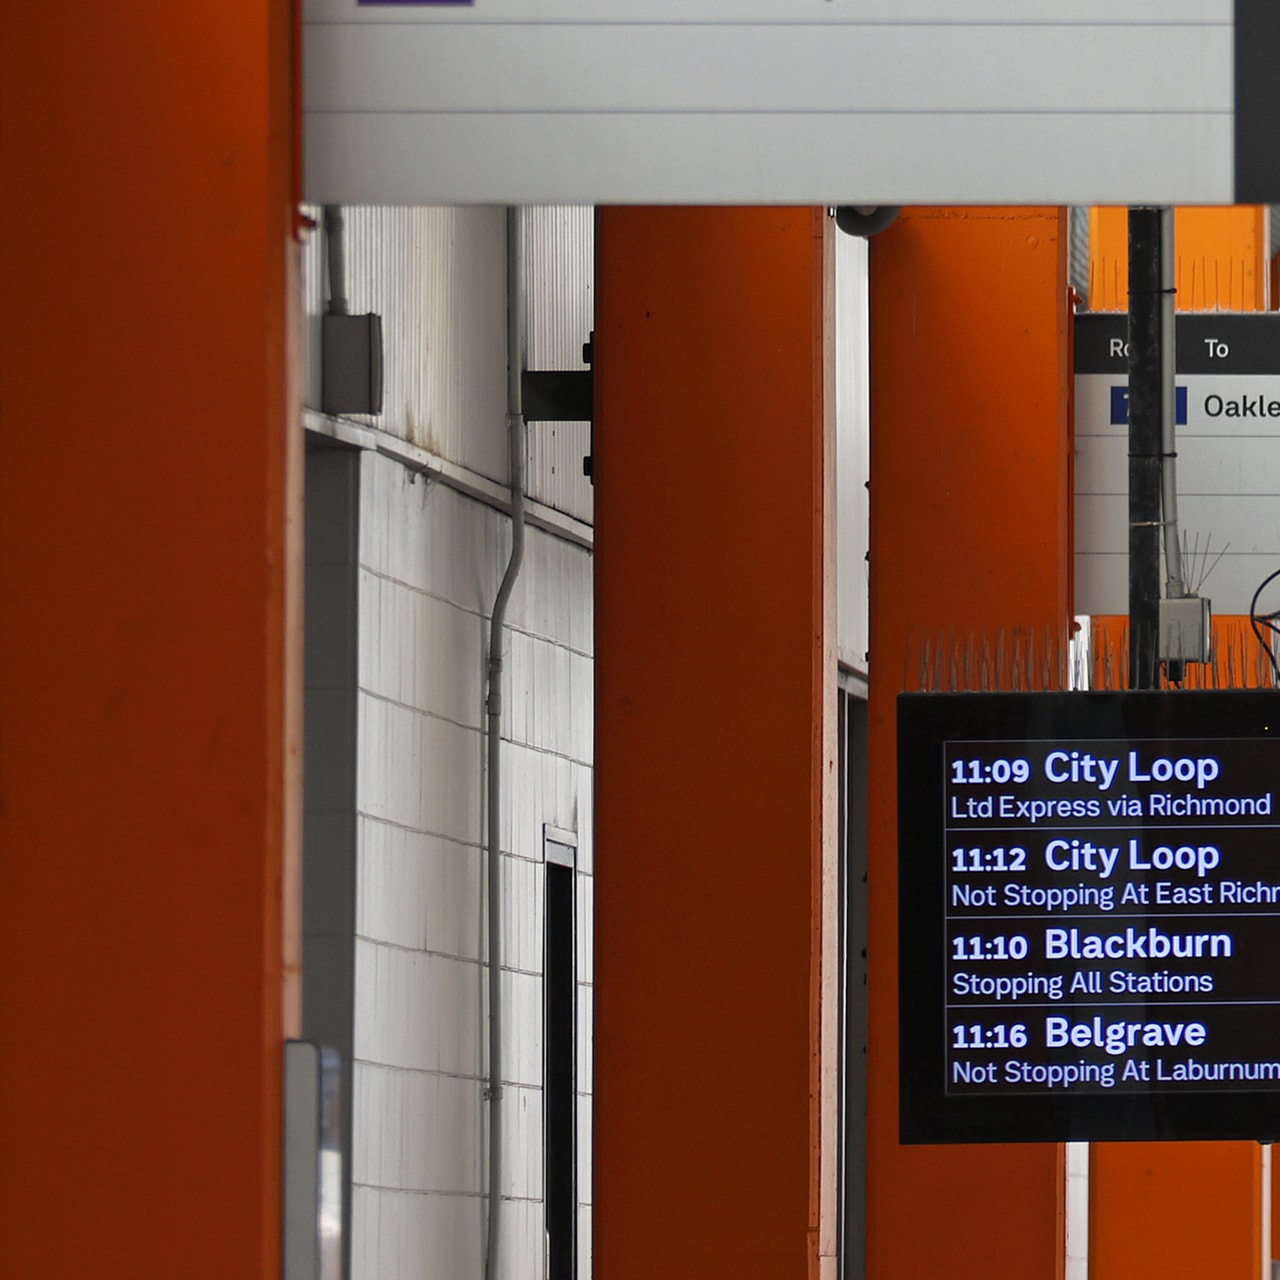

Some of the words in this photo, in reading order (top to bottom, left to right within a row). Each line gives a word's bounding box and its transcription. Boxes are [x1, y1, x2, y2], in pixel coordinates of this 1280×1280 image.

[1204, 338, 1229, 358] To
[951, 759, 1030, 784] 11:09
[1044, 751, 1119, 791] City
[1129, 751, 1219, 789] Loop
[952, 795, 993, 818] Ltd
[999, 795, 1101, 823] Express
[1107, 794, 1143, 817] via
[1149, 792, 1271, 816] Richmond
[952, 847, 1026, 872] 11:12
[1045, 839, 1120, 879] City
[1129, 839, 1220, 878] Loop
[952, 884, 997, 907] Not
[1004, 882, 1114, 911] Stopping
[1120, 882, 1150, 905] At
[1156, 882, 1213, 904] East
[952, 935, 1028, 960] 11:10
[1045, 927, 1231, 959] Blackburn
[953, 971, 1063, 1000] Stopping
[1069, 971, 1103, 994] All
[1109, 970, 1213, 993] Stations
[953, 1024, 1028, 1049] 11:16
[1046, 1016, 1206, 1055] Belgrave
[953, 1061, 998, 1083] Not
[1004, 1059, 1115, 1088] Stopping
[1121, 1059, 1150, 1081] At
